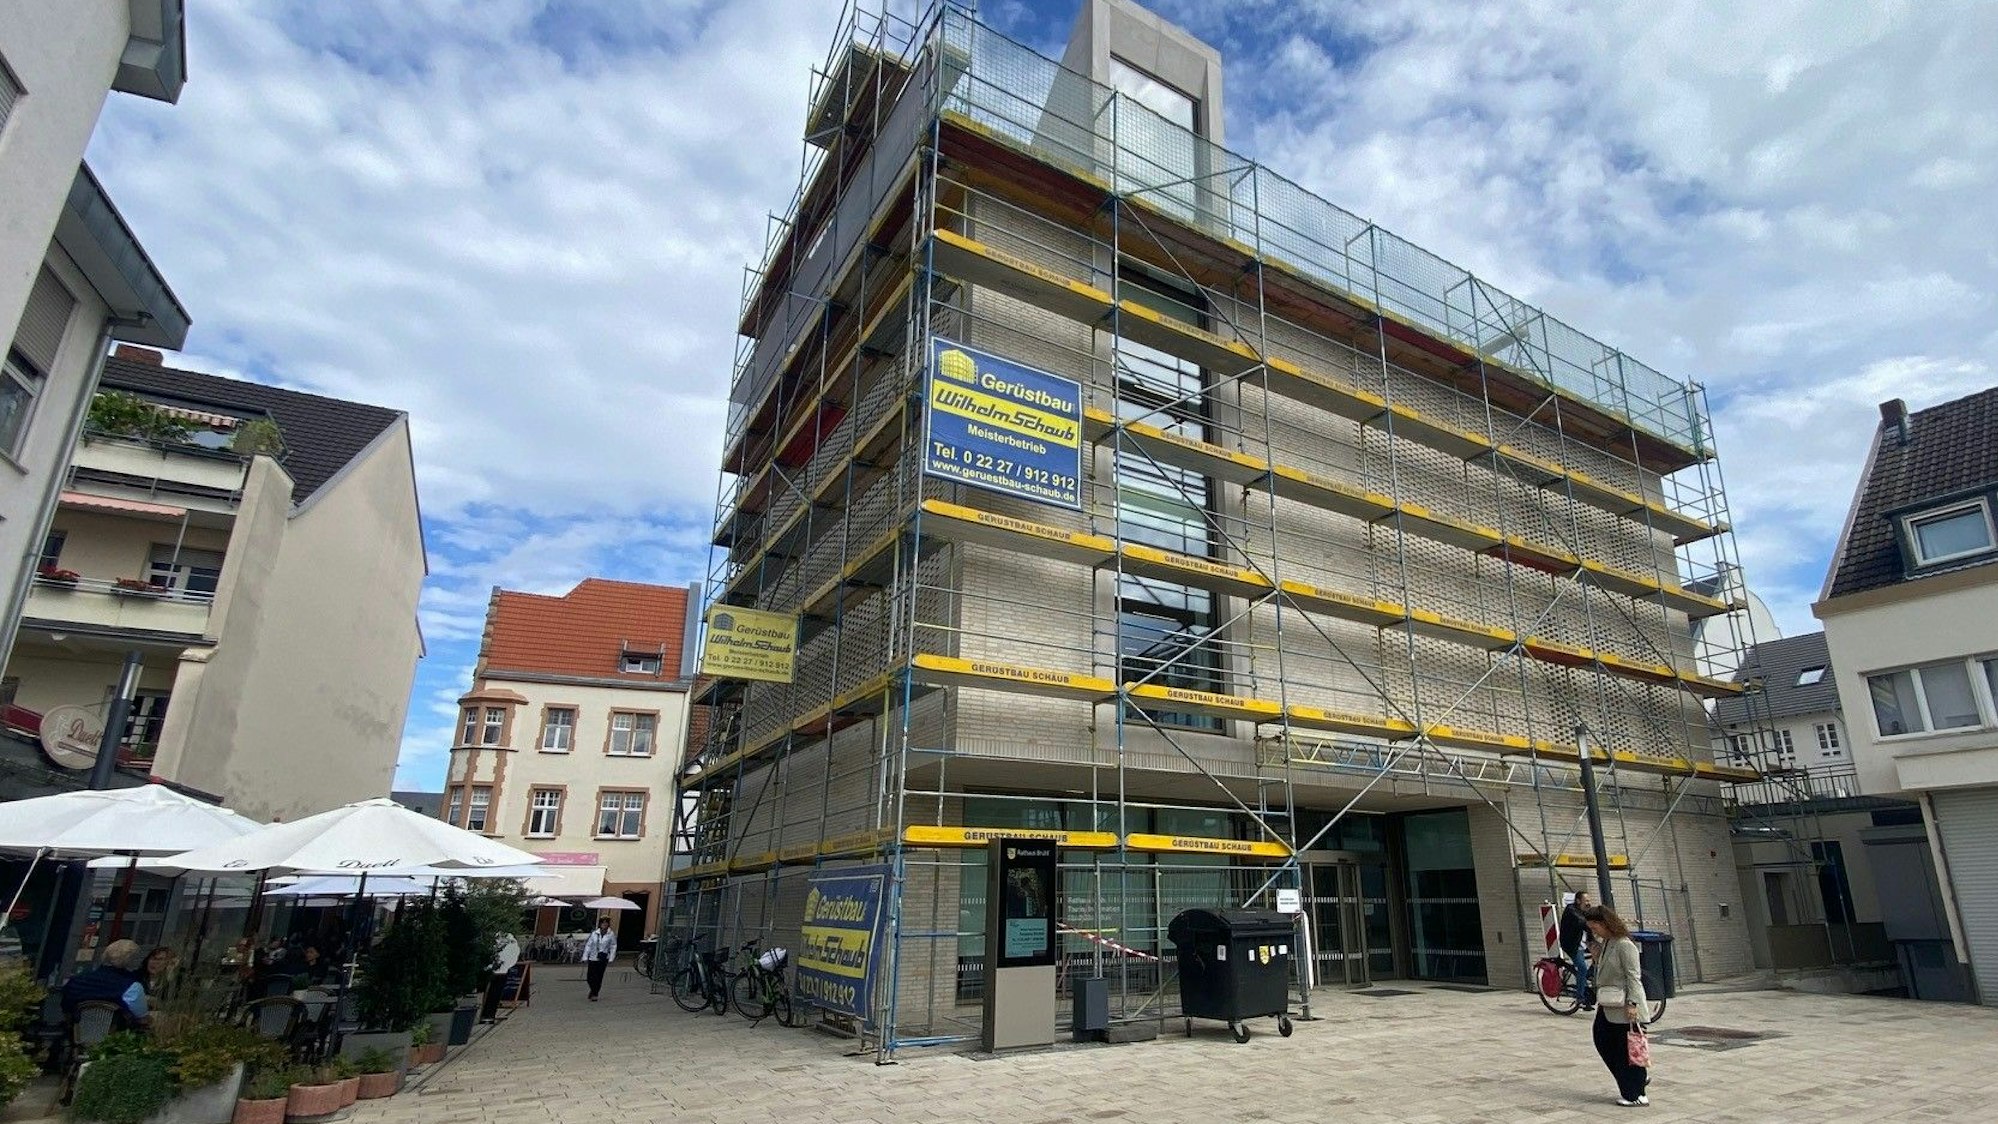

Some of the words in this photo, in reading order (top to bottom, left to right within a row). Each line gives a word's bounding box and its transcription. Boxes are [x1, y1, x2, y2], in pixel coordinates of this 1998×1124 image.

[981, 373, 1072, 413] Gerüstbau
[935, 388, 1010, 424] Wilhelm
[1008, 411, 1075, 442] Schaub
[968, 423, 1047, 455] Meisterbetrieb
[934, 442, 958, 461] Tel.
[964, 450, 972, 464] 0
[976, 453, 993, 470] 22
[997, 459, 1013, 474] 27
[1016, 464, 1021, 477] /
[1024, 467, 1048, 484] 912
[1052, 473, 1075, 491] 912
[932, 459, 1075, 502] www.geruestbau-schaub.de
[1036, 525, 1071, 540] SCHAUB
[736, 624, 790, 639] Gerüstbau
[1032, 671, 1070, 683] SCHAUB
[1215, 696, 1245, 707] SCHAUB
[1221, 842, 1252, 852] SCHAUB
